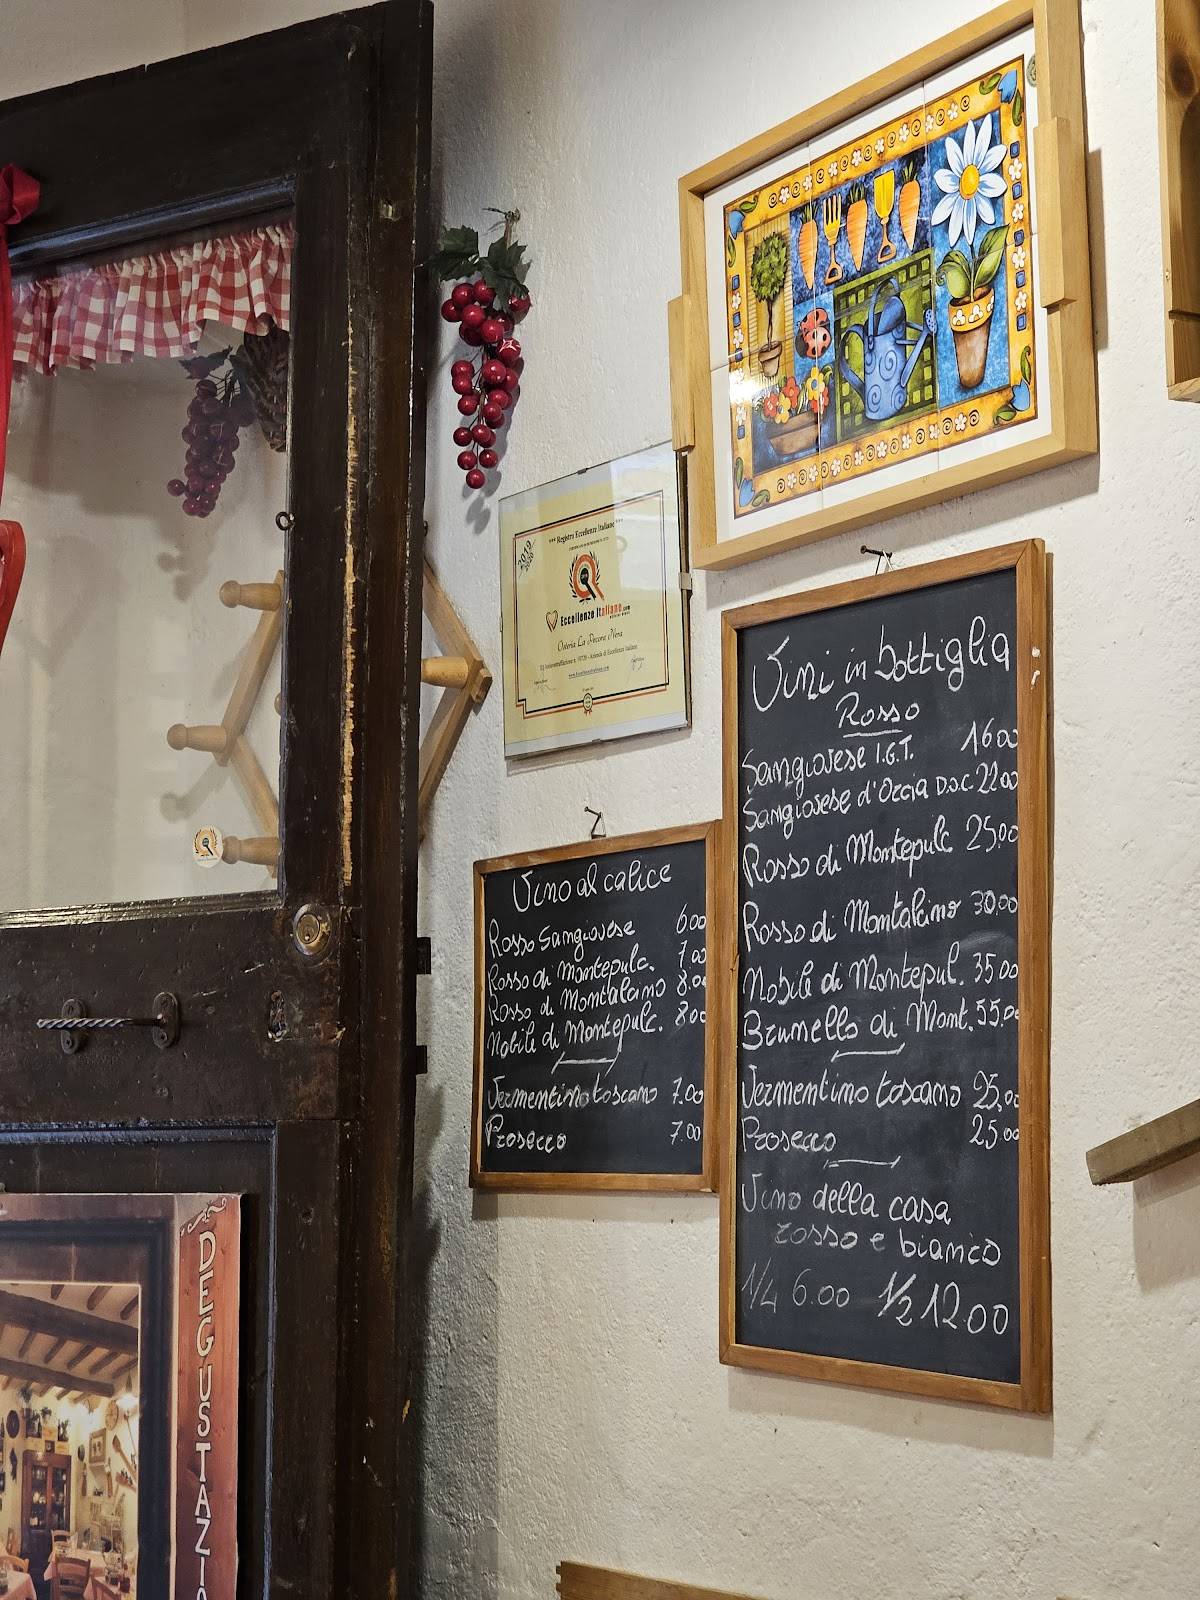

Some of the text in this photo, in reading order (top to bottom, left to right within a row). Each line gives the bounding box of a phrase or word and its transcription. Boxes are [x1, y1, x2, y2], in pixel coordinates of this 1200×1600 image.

[577, 635, 586, 647] La
[753, 616, 1010, 713] Vini in bottiglia
[835, 691, 920, 729] Rosso
[742, 746, 866, 800] Sangiovese
[742, 788, 851, 840] Sangiovese
[513, 860, 672, 912] Vino al calice
[742, 843, 810, 888] Rosso
[816, 843, 842, 876] di
[489, 919, 535, 959] Rosso
[538, 919, 636, 962] Sangiovese
[742, 887, 1019, 952] Rosso di Montalcino 30.00
[487, 963, 529, 994] Rosso
[532, 964, 554, 990] di
[742, 960, 813, 1005] Nobile
[820, 962, 844, 995] di
[488, 990, 532, 1026] Rosso
[540, 996, 555, 1017] di
[742, 1005, 859, 1051] Brunello
[870, 1007, 899, 1039] di
[486, 1021, 537, 1059] Nobile
[542, 1022, 560, 1050] di
[488, 1072, 704, 1110] Vermentino toscano 7.00
[742, 1064, 869, 1109] Vermentino
[485, 1114, 567, 1153] Prosecco
[741, 1115, 837, 1153] Prosecco
[742, 1173, 952, 1226] Vino della casa
[774, 1222, 1001, 1267] rosso e bianco
[741, 1257, 778, 1313] 1/4
[792, 1268, 850, 1307] 6.00
